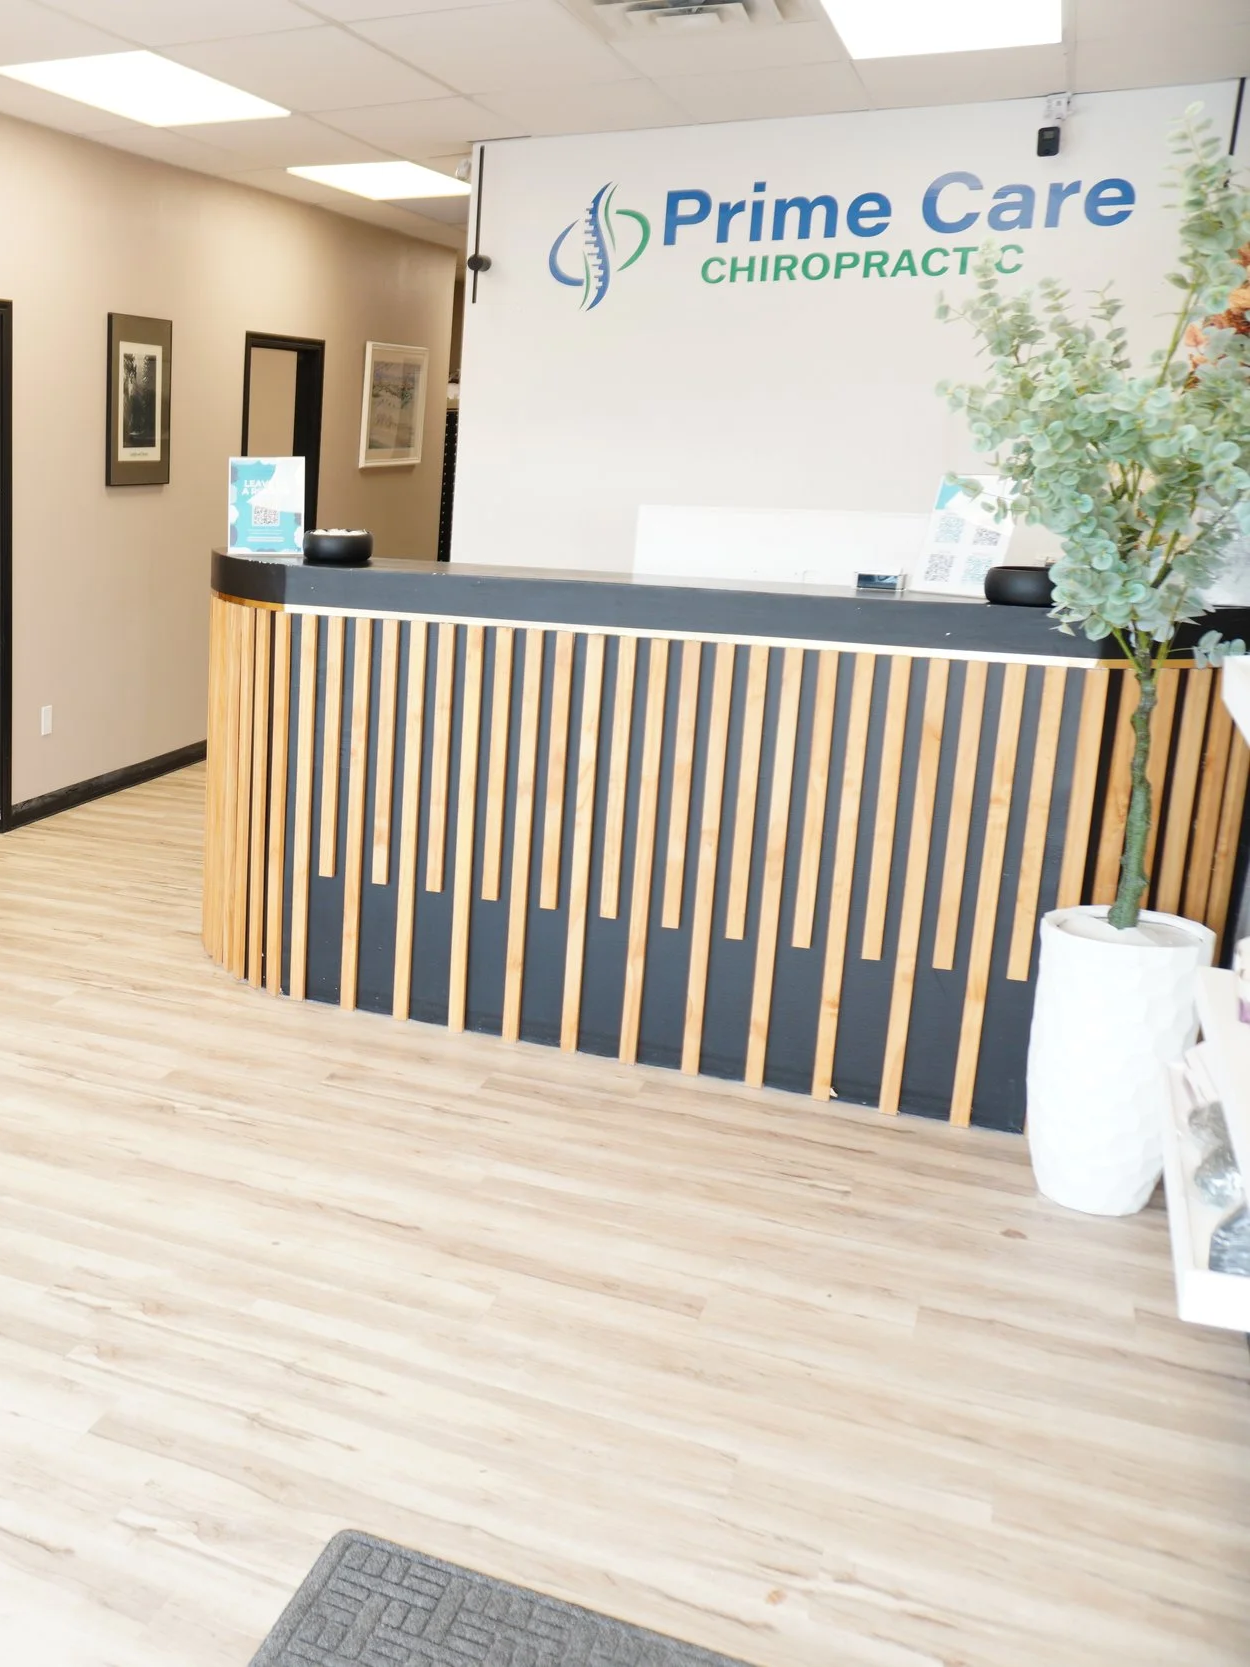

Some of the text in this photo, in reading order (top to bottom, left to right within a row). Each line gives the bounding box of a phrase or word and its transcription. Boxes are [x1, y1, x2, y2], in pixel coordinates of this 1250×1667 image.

[662, 171, 1136, 246] Prime Care
[700, 244, 1025, 284] CHIROPRACTC
